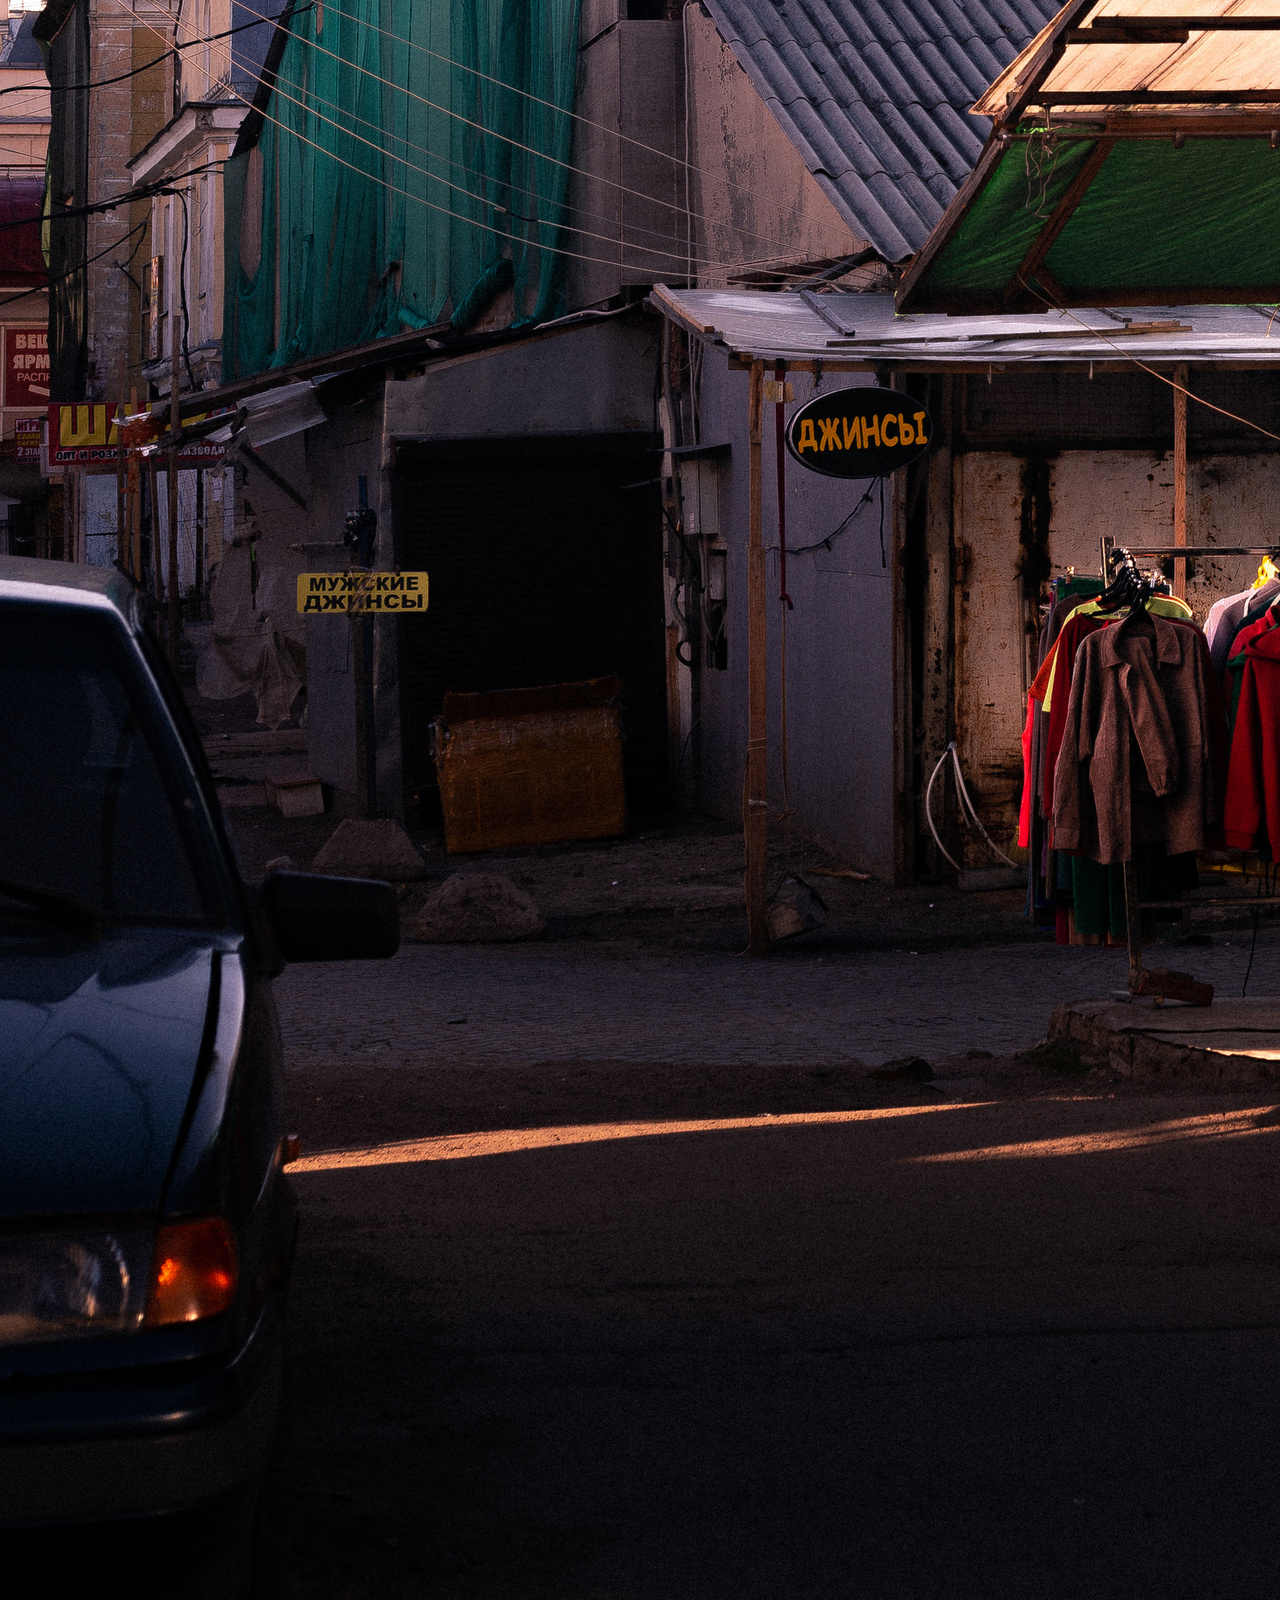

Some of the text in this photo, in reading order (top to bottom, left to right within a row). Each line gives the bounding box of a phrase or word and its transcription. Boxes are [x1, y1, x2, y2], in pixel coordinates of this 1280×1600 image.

[798, 411, 928, 453] ДЖИНСЫ
[17, 447, 24, 456] 2
[56, 450, 77, 461] ОПТ
[79, 450, 88, 460] И
